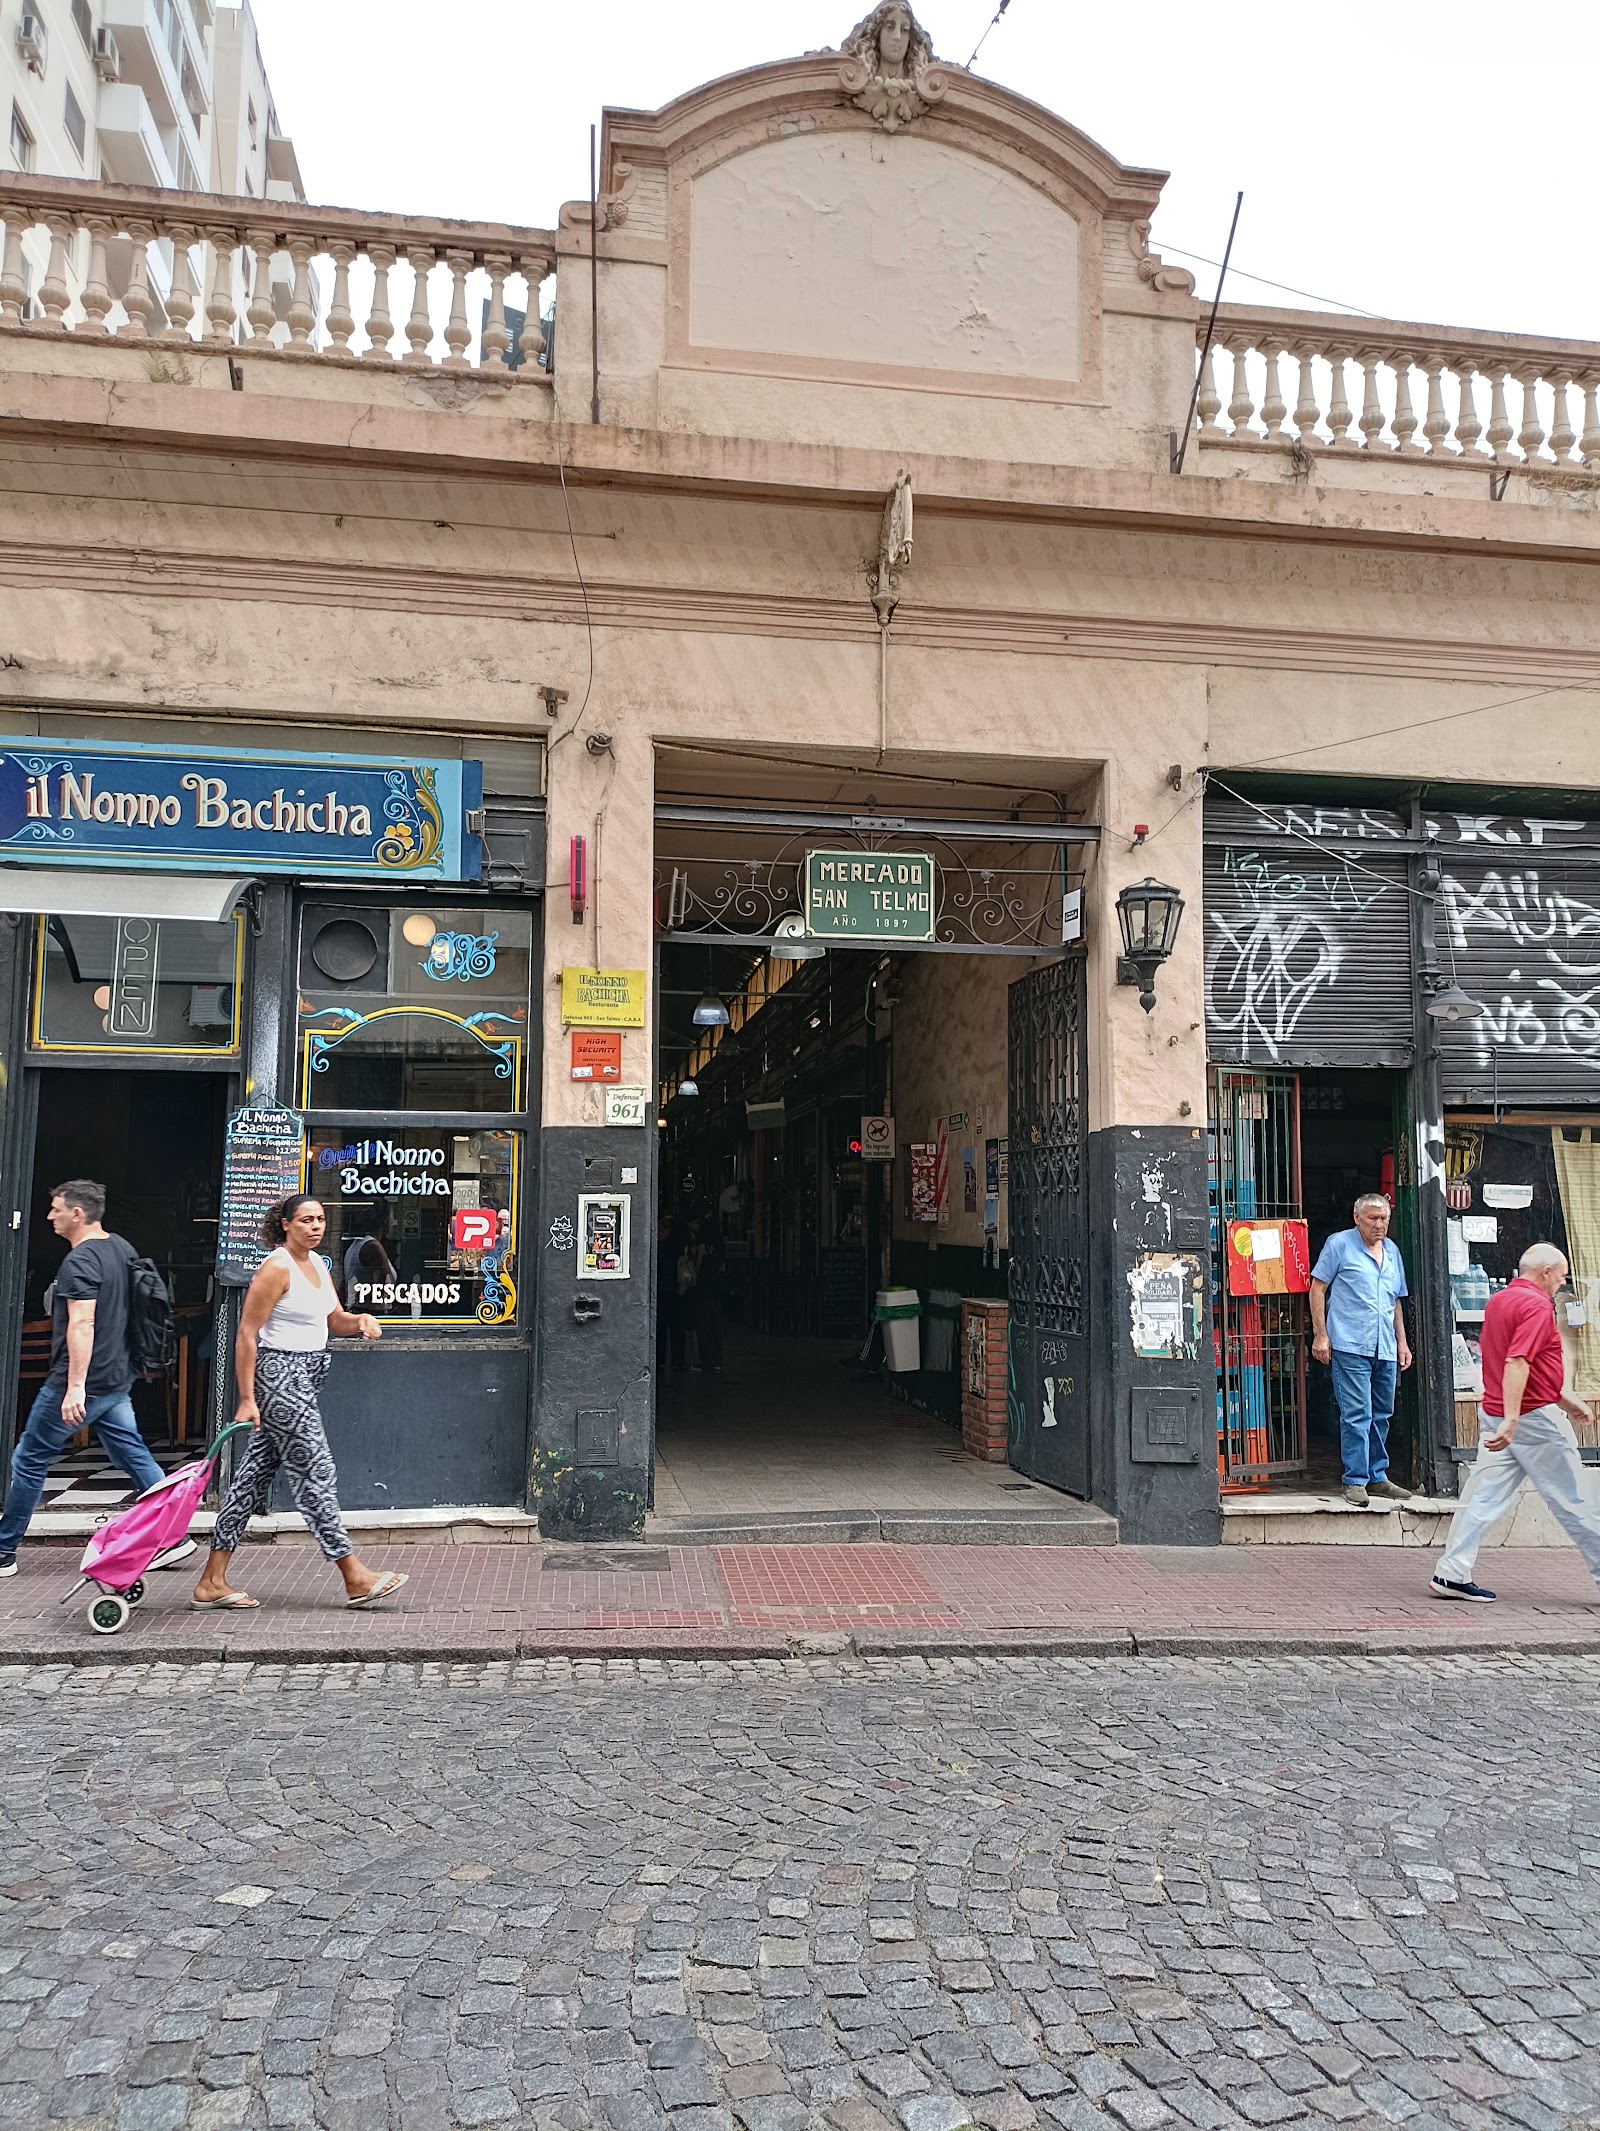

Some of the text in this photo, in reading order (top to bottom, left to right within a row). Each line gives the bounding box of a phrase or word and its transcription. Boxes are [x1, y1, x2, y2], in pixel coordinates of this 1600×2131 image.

[26, 771, 372, 838] il Nonno Bachicha
[820, 861, 922, 885] MERCADO
[812, 887, 929, 912] SAN TELMO
[832, 914, 908, 928] AÑO 1897
[120, 917, 152, 1028] OPEN
[580, 974, 628, 987] IL NONNO
[577, 988, 631, 1003] BACHICHA
[612, 1093, 640, 1101] Defensa
[611, 1103, 640, 1119] 961
[235, 1121, 293, 1134] Bachicha
[356, 1139, 445, 1167] il Nonno
[873, 1143, 890, 1152] ingresar
[340, 1168, 451, 1196] Bachicha
[227, 1241, 257, 1250] ENTRAÑA
[227, 1253, 243, 1262] BIFE
[1149, 1281, 1173, 1290] PEÑA
[353, 1283, 461, 1304] PESCADOS
